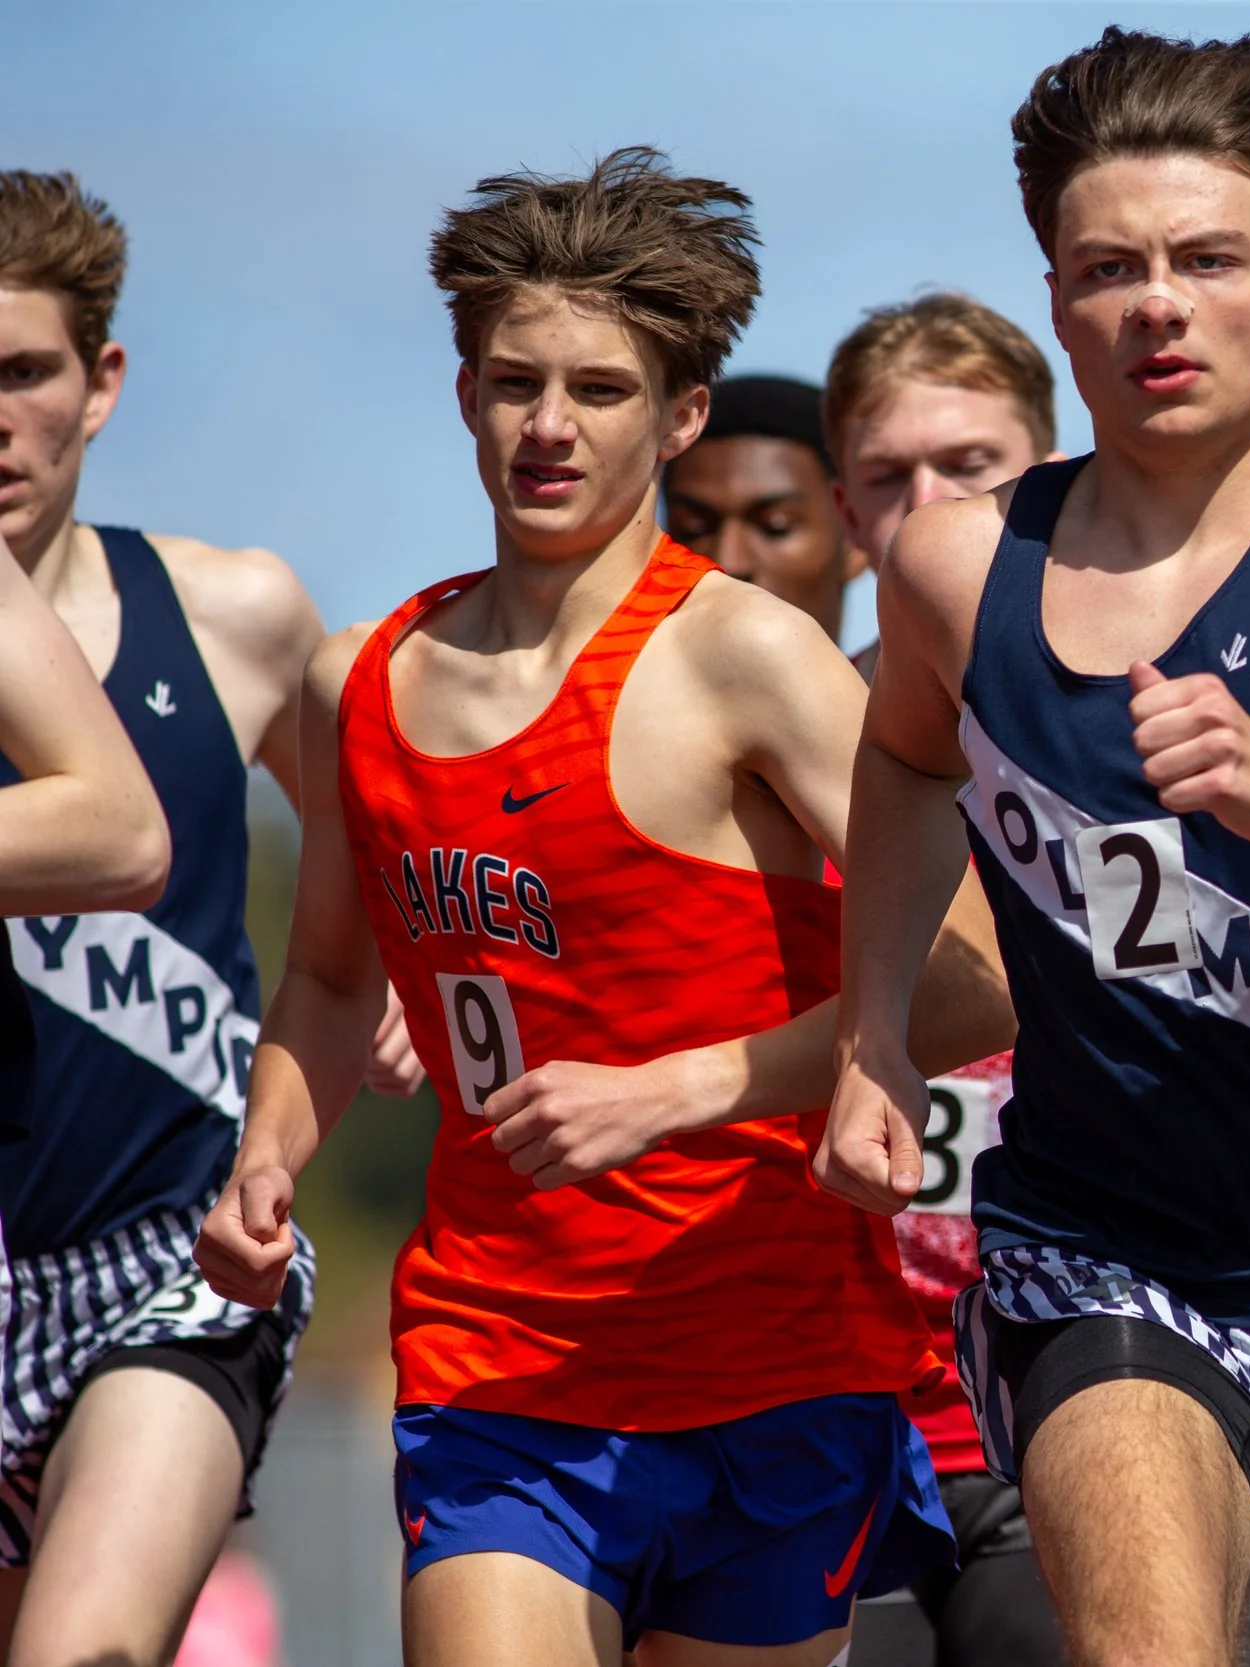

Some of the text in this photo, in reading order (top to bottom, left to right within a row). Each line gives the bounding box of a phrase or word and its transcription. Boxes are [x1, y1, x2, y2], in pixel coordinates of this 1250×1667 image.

[380, 848, 560, 960] LAKES
[1100, 832, 1179, 970] 2
[454, 981, 508, 1106] 9
